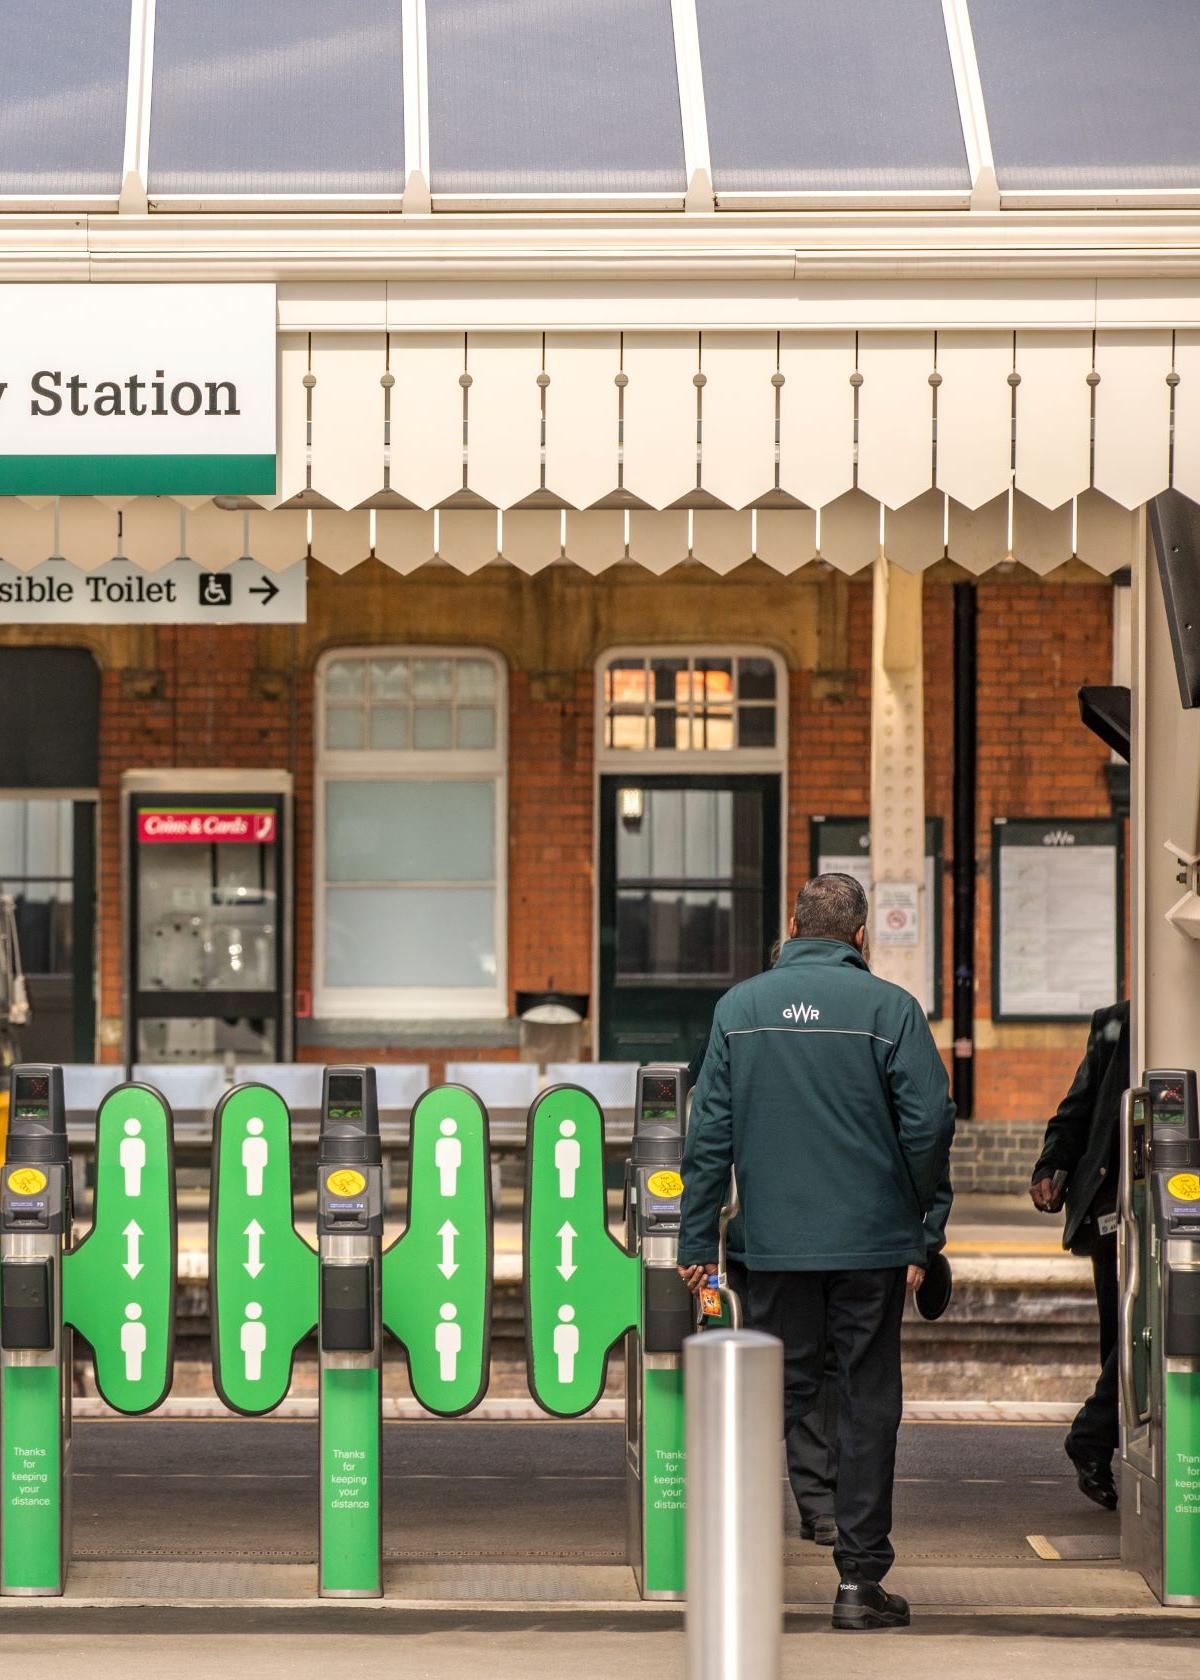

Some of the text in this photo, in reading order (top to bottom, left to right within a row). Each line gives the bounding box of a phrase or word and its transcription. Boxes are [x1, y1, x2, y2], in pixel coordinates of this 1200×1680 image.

[31, 369, 241, 417] Station
[85, 575, 177, 603] Toilet
[144, 816, 248, 835] Coins & Cards
[782, 1001, 820, 1024] GWR
[14, 1447, 46, 1456] Thanks
[332, 1449, 366, 1459] Thanks
[1176, 1453, 1200, 1463] Than
[23, 1459, 36, 1469] for
[342, 1462, 355, 1471] for
[665, 1462, 678, 1472] for
[11, 1472, 48, 1482] keeping
[331, 1474, 367, 1486] keeping
[1175, 1479, 1200, 1490] keepi
[19, 1486, 40, 1494] your
[339, 1488, 359, 1497] your
[662, 1489, 682, 1498] your
[11, 1497, 50, 1506] distance
[1183, 1493, 1200, 1502] you
[331, 1500, 369, 1509] distance
[654, 1500, 687, 1509] distanc
